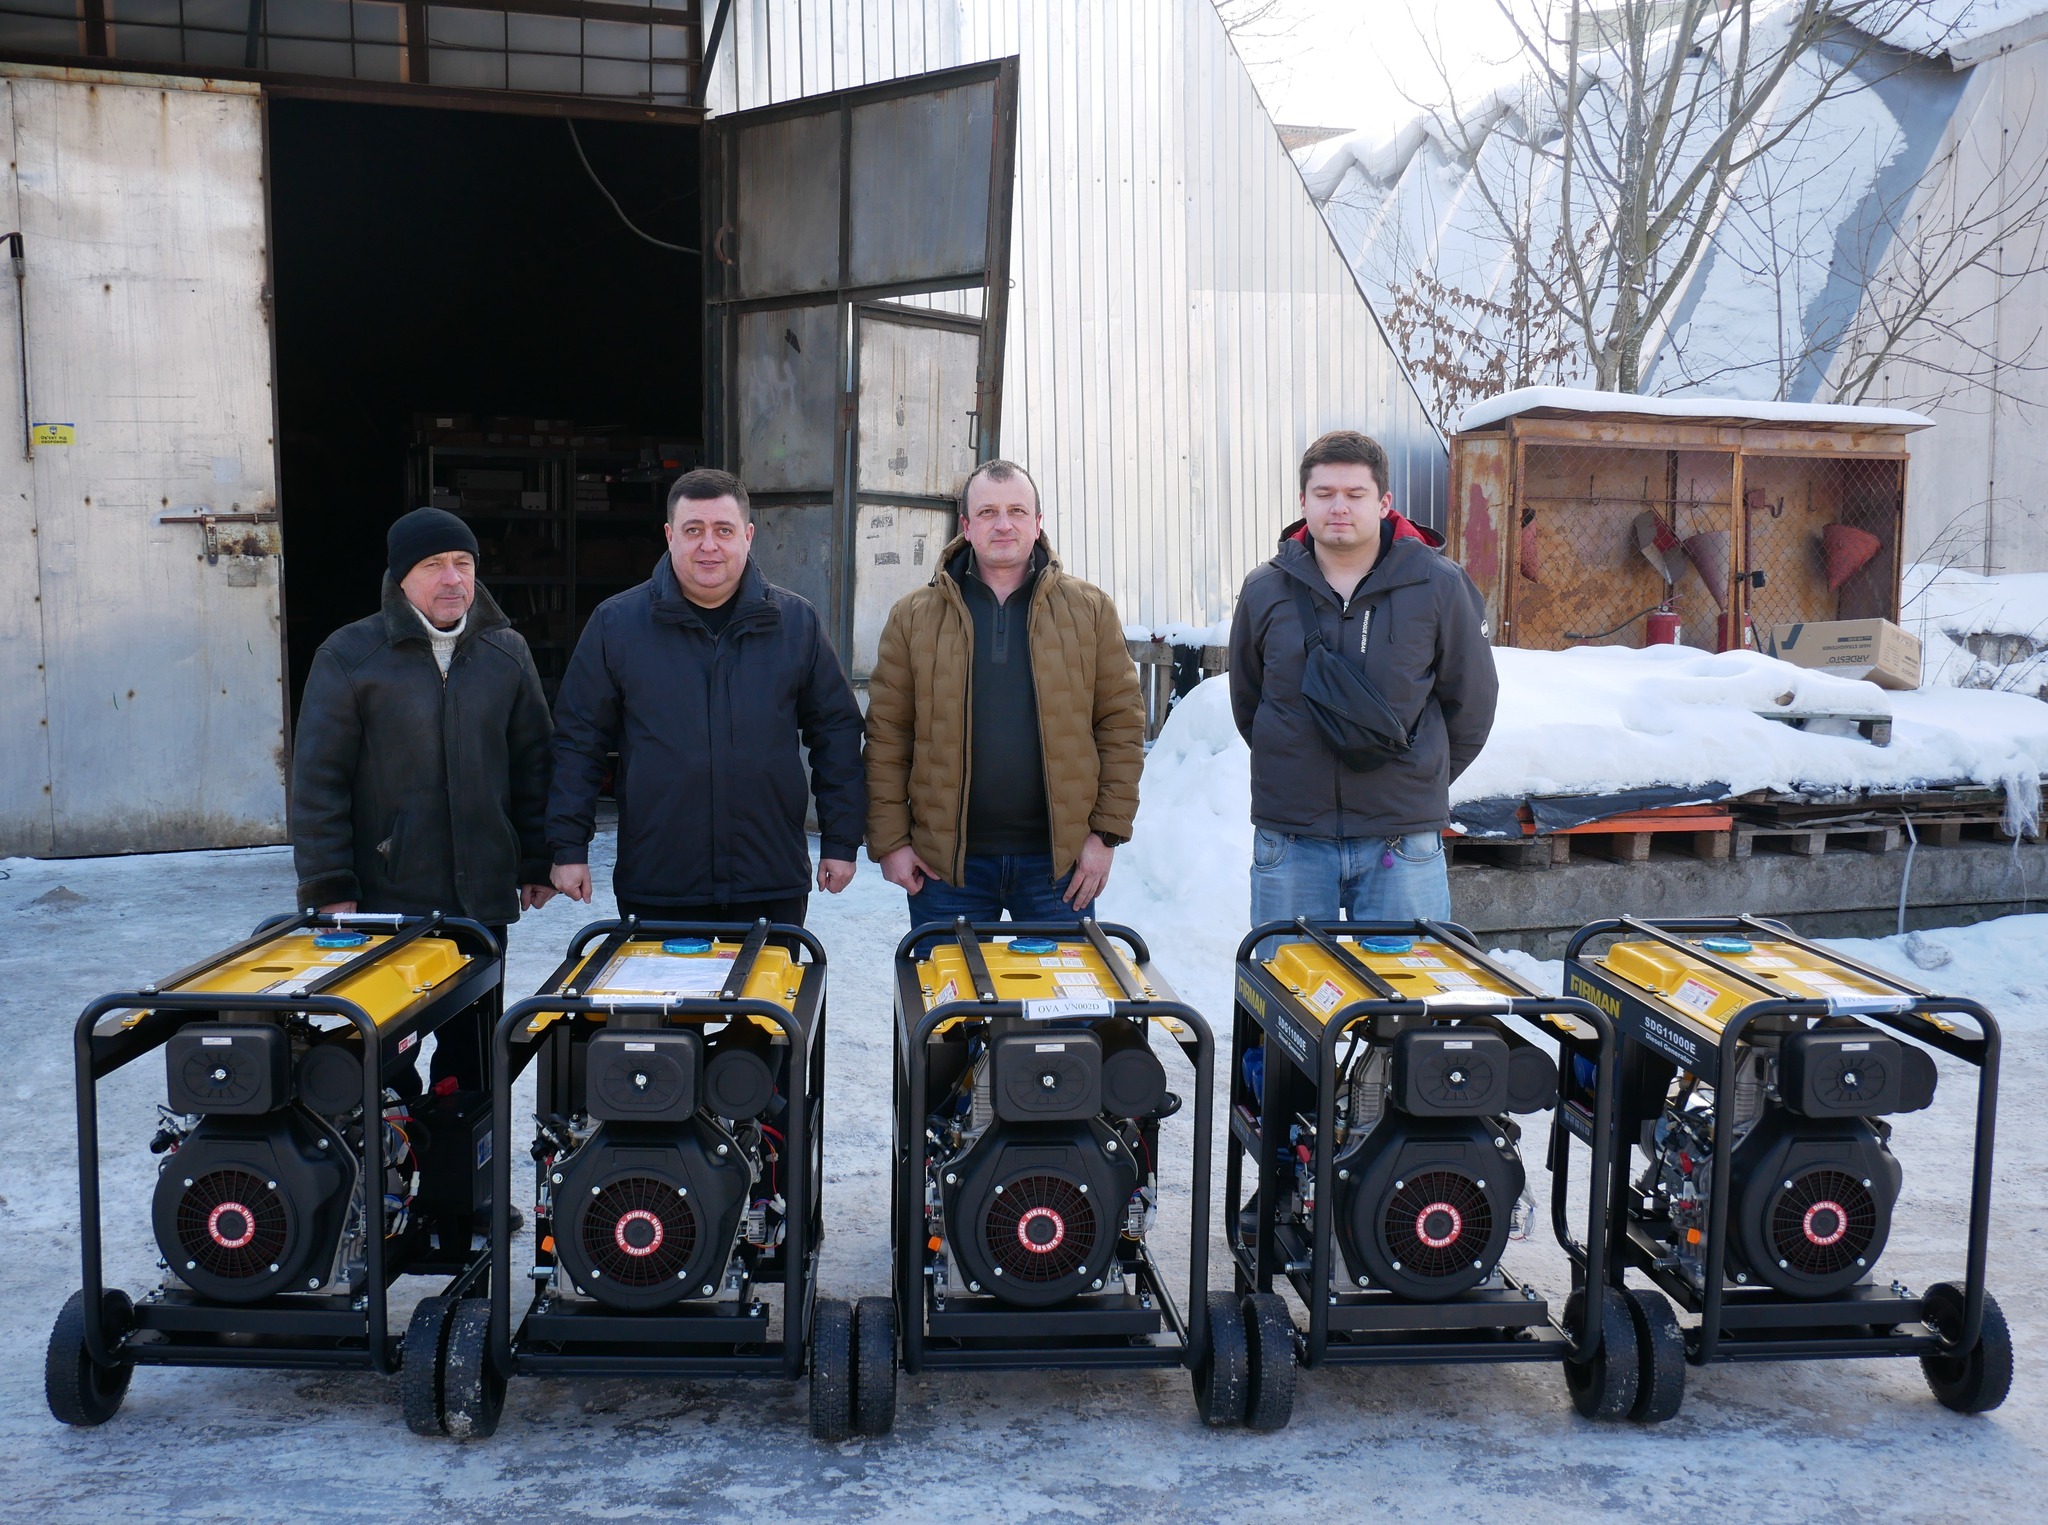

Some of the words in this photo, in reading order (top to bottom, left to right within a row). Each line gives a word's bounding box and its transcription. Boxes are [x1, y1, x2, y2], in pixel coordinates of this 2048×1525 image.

[1829, 655, 1870, 664] ARDESTO
[1238, 975, 1266, 1019] FIRMAN
[1570, 974, 1620, 1019] FIRMAN
[1038, 1003, 1099, 1014] OVA_VN002D
[1278, 1015, 1306, 1052] SDG11000E
[1644, 1016, 1696, 1055] SDG11000E
[1645, 1032, 1663, 1048] Diesel
[1663, 1043, 1693, 1065] Generator
[218, 1204, 242, 1212] DIESEL
[626, 1211, 651, 1220] DIESEL
[1026, 1209, 1051, 1219] DIESEL
[1426, 1204, 1449, 1213] DIESEL
[1813, 1203, 1837, 1211] DIESEL
[210, 1212, 219, 1237] DIESEL
[243, 1210, 253, 1236] DIESEL
[651, 1218, 661, 1245] DIESEL
[1019, 1221, 1029, 1243] DIESEL
[1052, 1215, 1063, 1238] DIESEL
[1417, 1214, 1426, 1239] DIESEL
[1449, 1209, 1459, 1235] DIESEL
[1804, 1212, 1813, 1234] DIESEL
[1836, 1210, 1845, 1232] DIESEL
[221, 1237, 244, 1247] DIESEL
[617, 1220, 626, 1245] DIESEL
[1427, 1237, 1450, 1246] DIESEL
[1813, 1232, 1839, 1243] DIESEL
[626, 1245, 650, 1255] DIESEL
[1031, 1239, 1058, 1250] DIESEL
